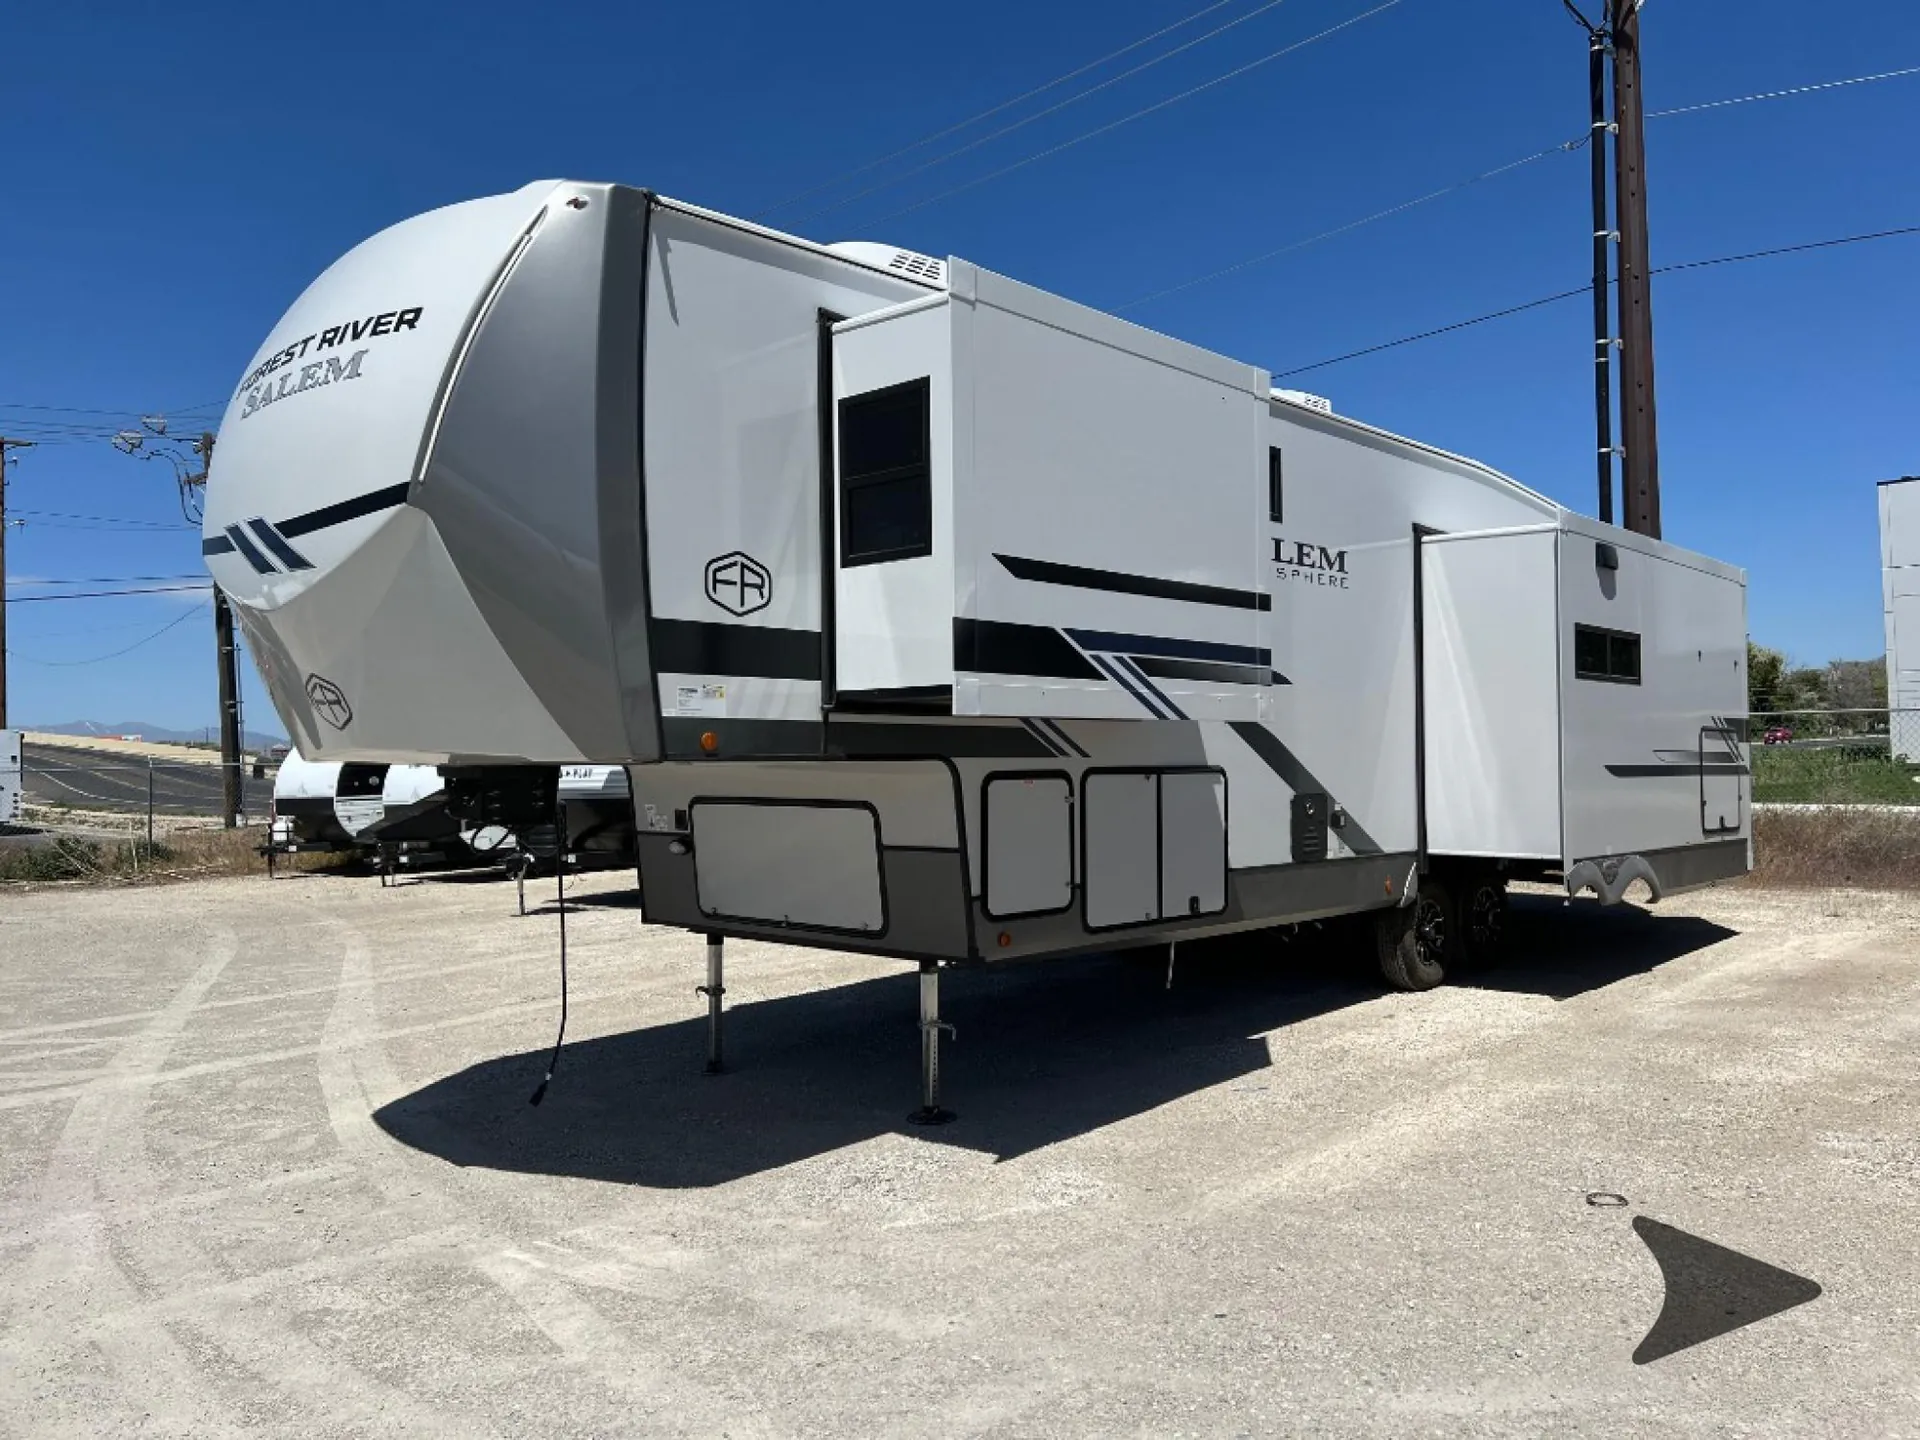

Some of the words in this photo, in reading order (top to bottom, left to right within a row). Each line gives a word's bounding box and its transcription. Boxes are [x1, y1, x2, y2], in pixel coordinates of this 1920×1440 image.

[317, 306, 424, 351] RIVER
[240, 348, 369, 420] SALEM
[1270, 536, 1349, 574] LEM
[1276, 567, 1349, 590] SPHERE
